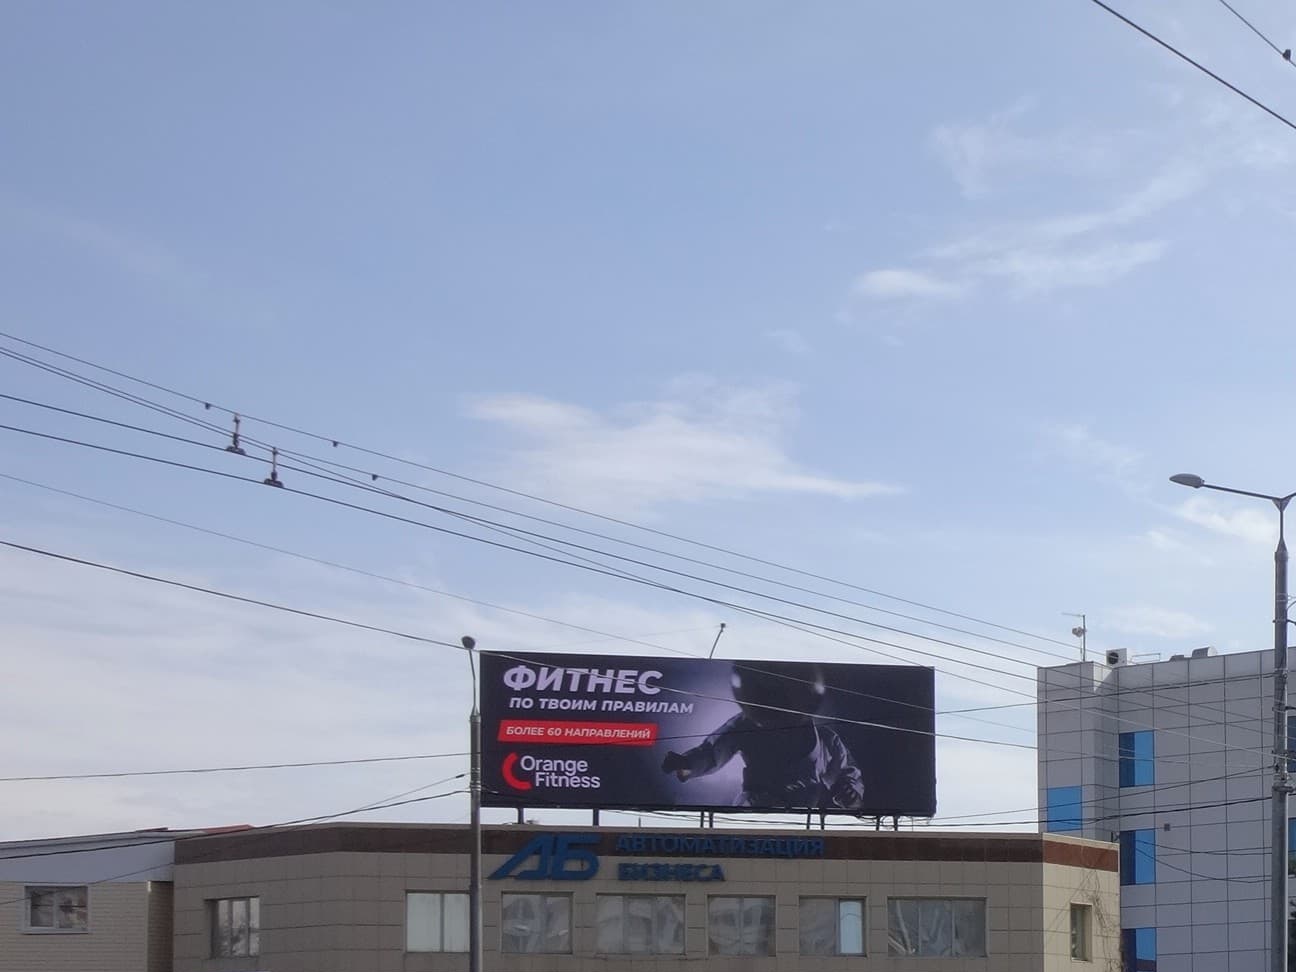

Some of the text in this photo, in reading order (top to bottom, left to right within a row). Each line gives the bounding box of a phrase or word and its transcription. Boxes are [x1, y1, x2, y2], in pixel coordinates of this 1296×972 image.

[503, 665, 663, 695] ФИТНЕС
[509, 697, 694, 714] ПО ТВОИМ ПРАВИЛАМ
[506, 726, 651, 739] БОЛЕЕ 60 НАПРАВЛЕНИЙ
[520, 755, 588, 776] Orange
[535, 771, 600, 788] Fitness
[486, 833, 601, 881] АБ
[616, 836, 825, 858] АВТОМАТИЗАЦИЯ
[618, 863, 726, 882] БИЗНЕСА
